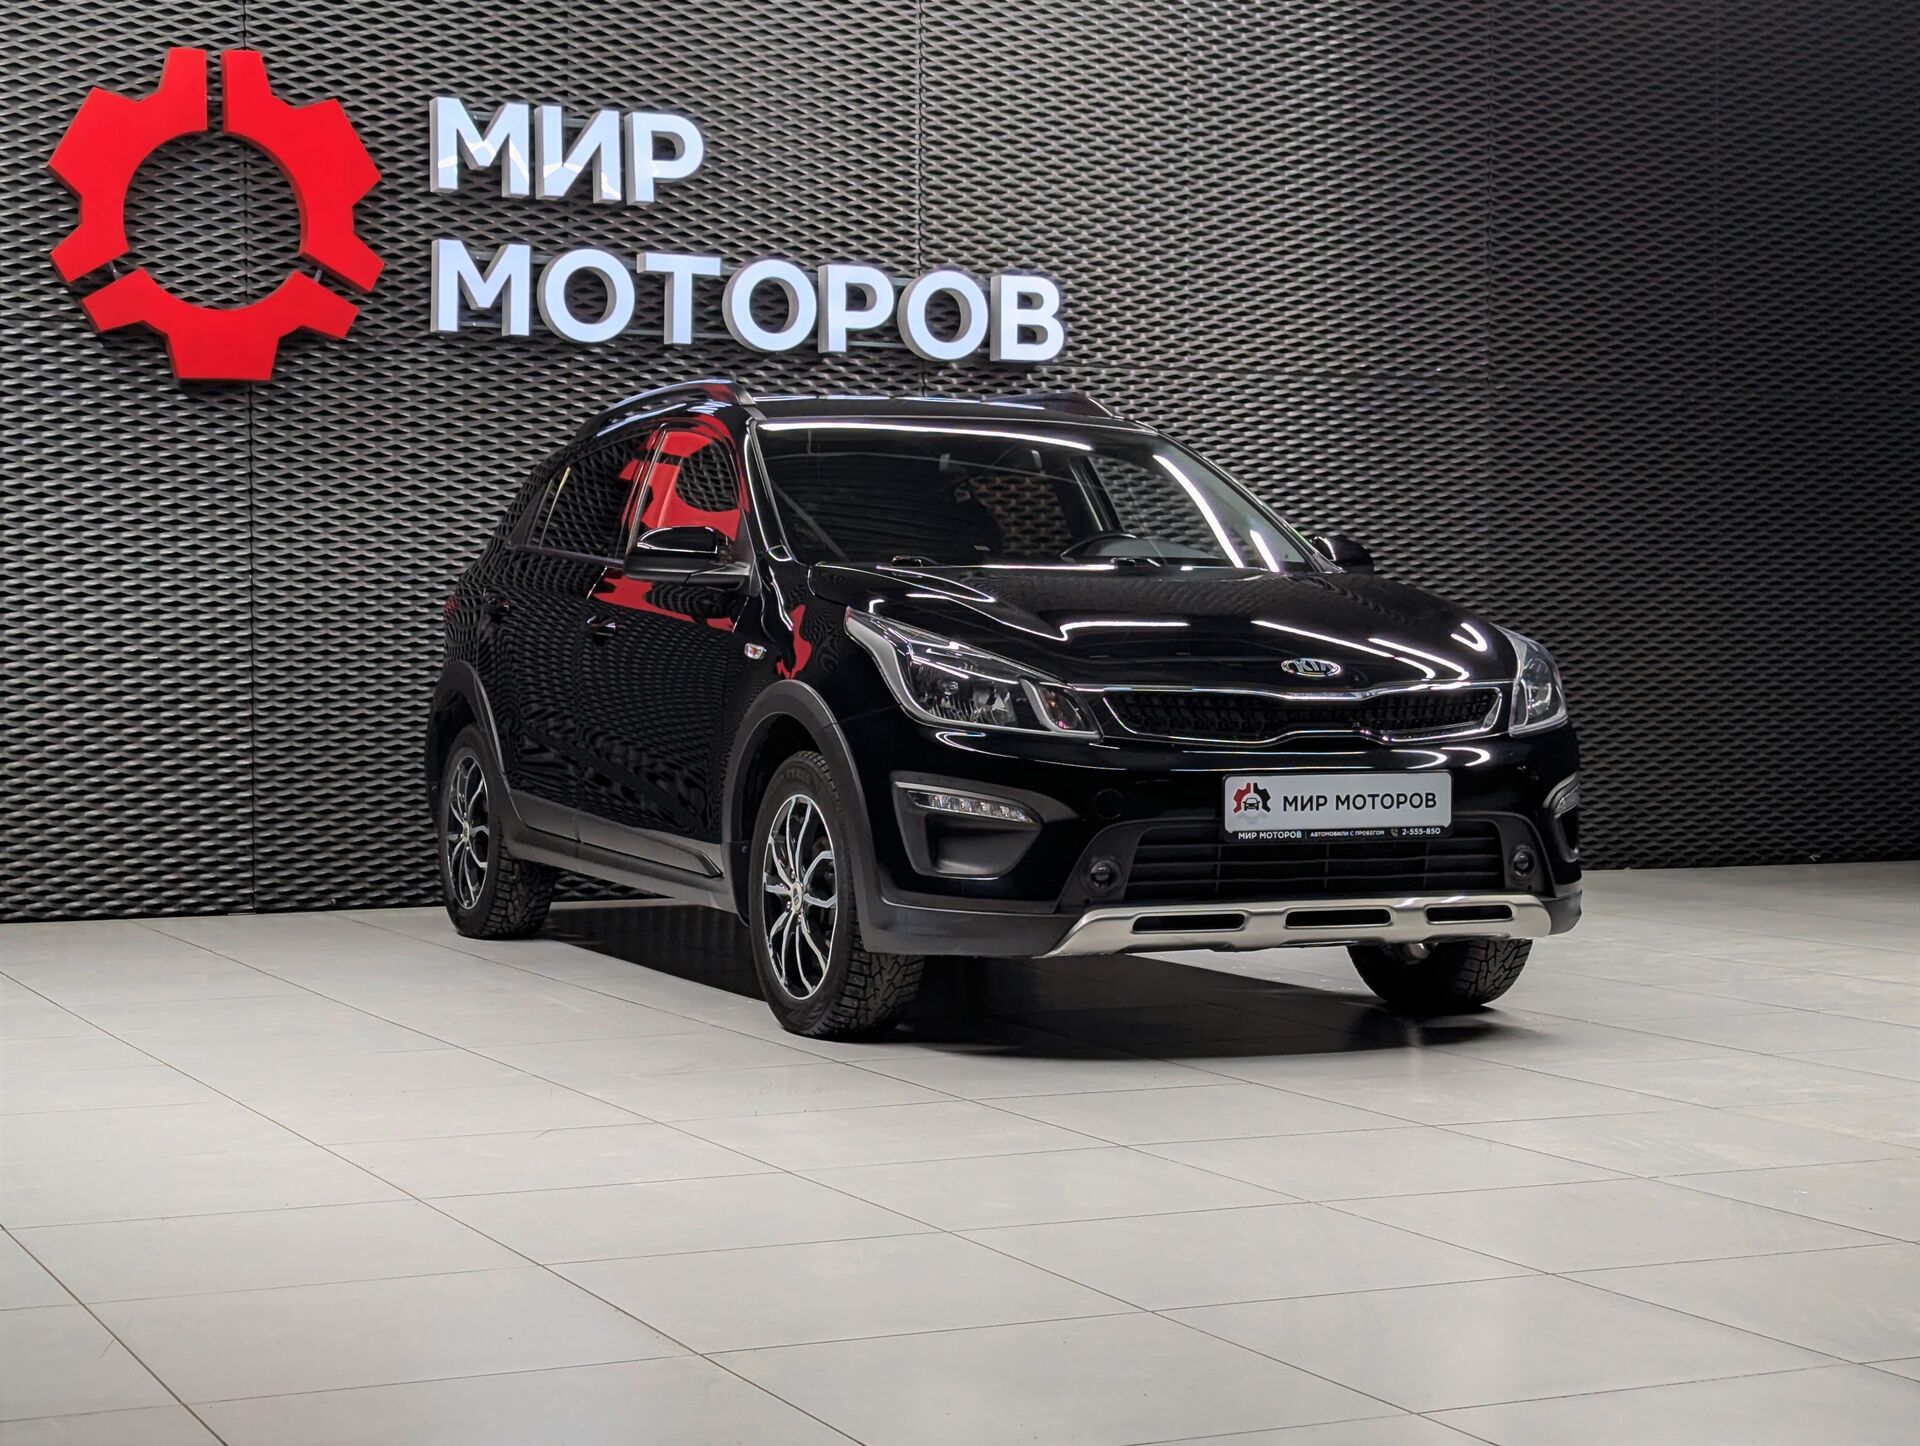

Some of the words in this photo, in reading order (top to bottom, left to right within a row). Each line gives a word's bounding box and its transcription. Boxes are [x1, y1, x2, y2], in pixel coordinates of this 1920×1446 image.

[430, 96, 703, 205] МИР
[430, 238, 1065, 362] МОТОРОВ
[1238, 831, 1257, 840] МИР
[1259, 830, 1302, 839] МОТОРОВ
[1402, 827, 1441, 836] 2-555-850
[1282, 794, 1329, 812] МИР
[1335, 792, 1437, 811] МОТОРОВ
